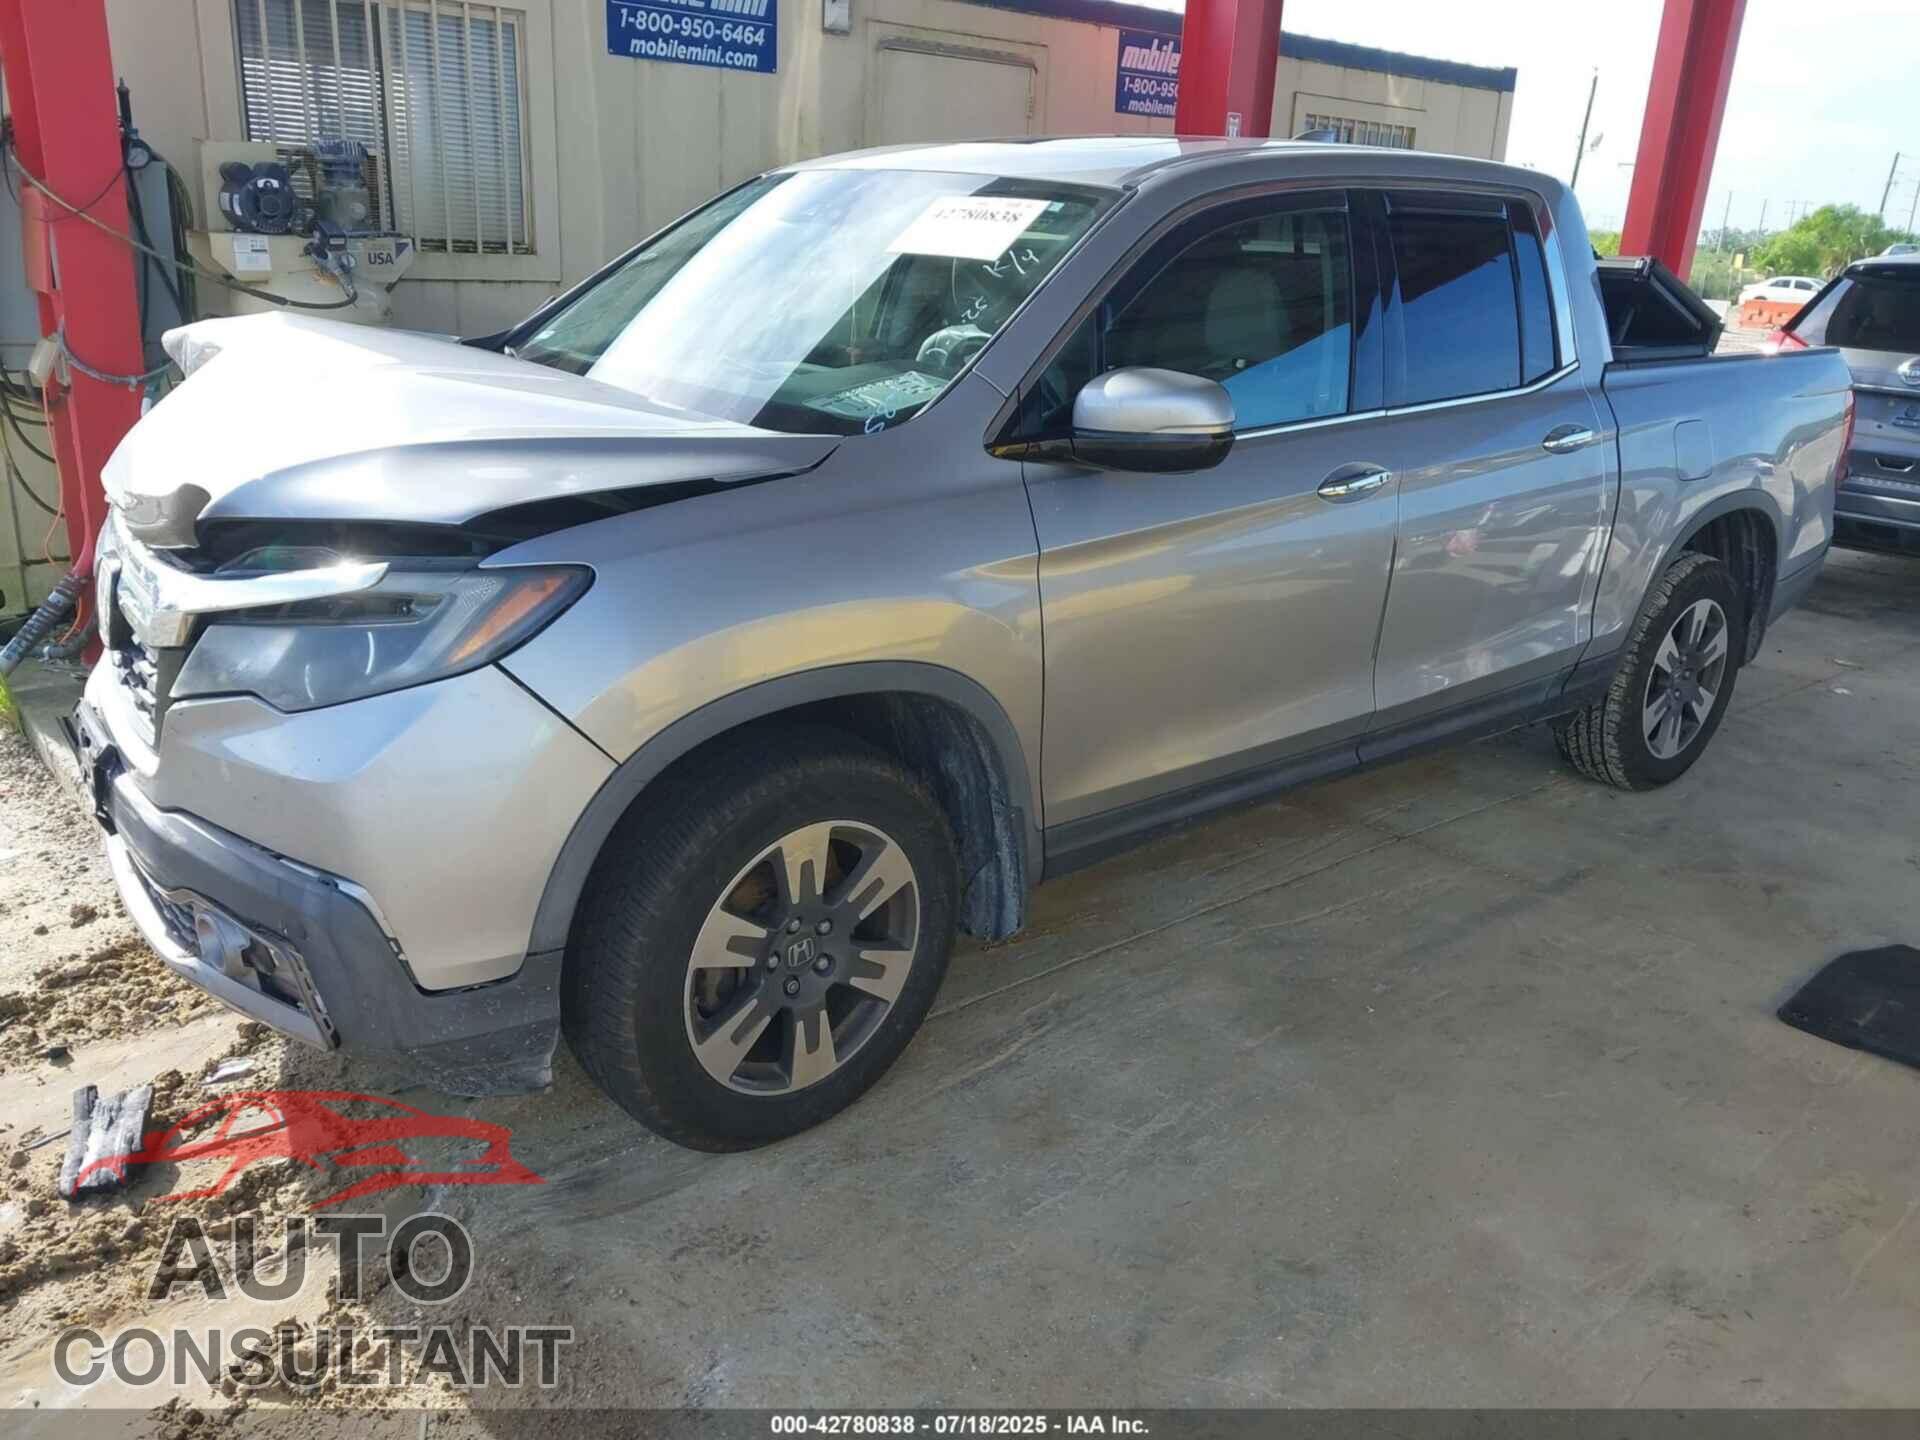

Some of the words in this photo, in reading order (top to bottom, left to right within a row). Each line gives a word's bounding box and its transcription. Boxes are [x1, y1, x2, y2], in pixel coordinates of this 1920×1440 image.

[620, 8, 765, 46] 1-800-950-6464
[630, 38, 758, 67] mobilemini.com
[1121, 38, 1181, 73] mobile
[1124, 77, 1178, 97] 1-800-95
[368, 252, 394, 265] USA
